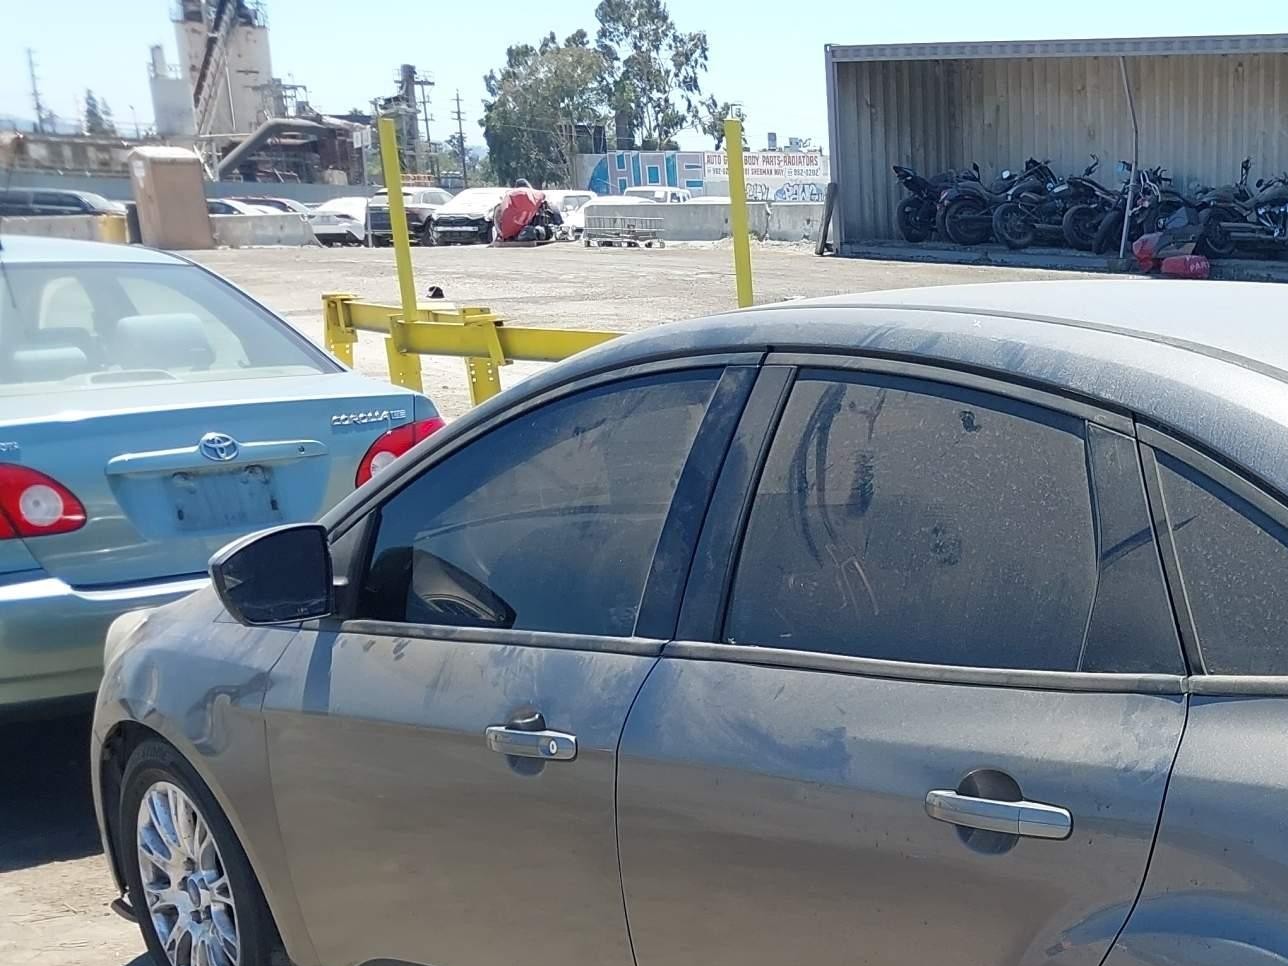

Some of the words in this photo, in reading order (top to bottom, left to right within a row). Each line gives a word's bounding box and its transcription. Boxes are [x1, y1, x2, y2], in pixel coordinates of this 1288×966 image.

[706, 154, 722, 165] AUTO
[744, 155, 759, 166] BODY
[774, 168, 784, 176] WAY
[332, 410, 390, 425] COROLLA
